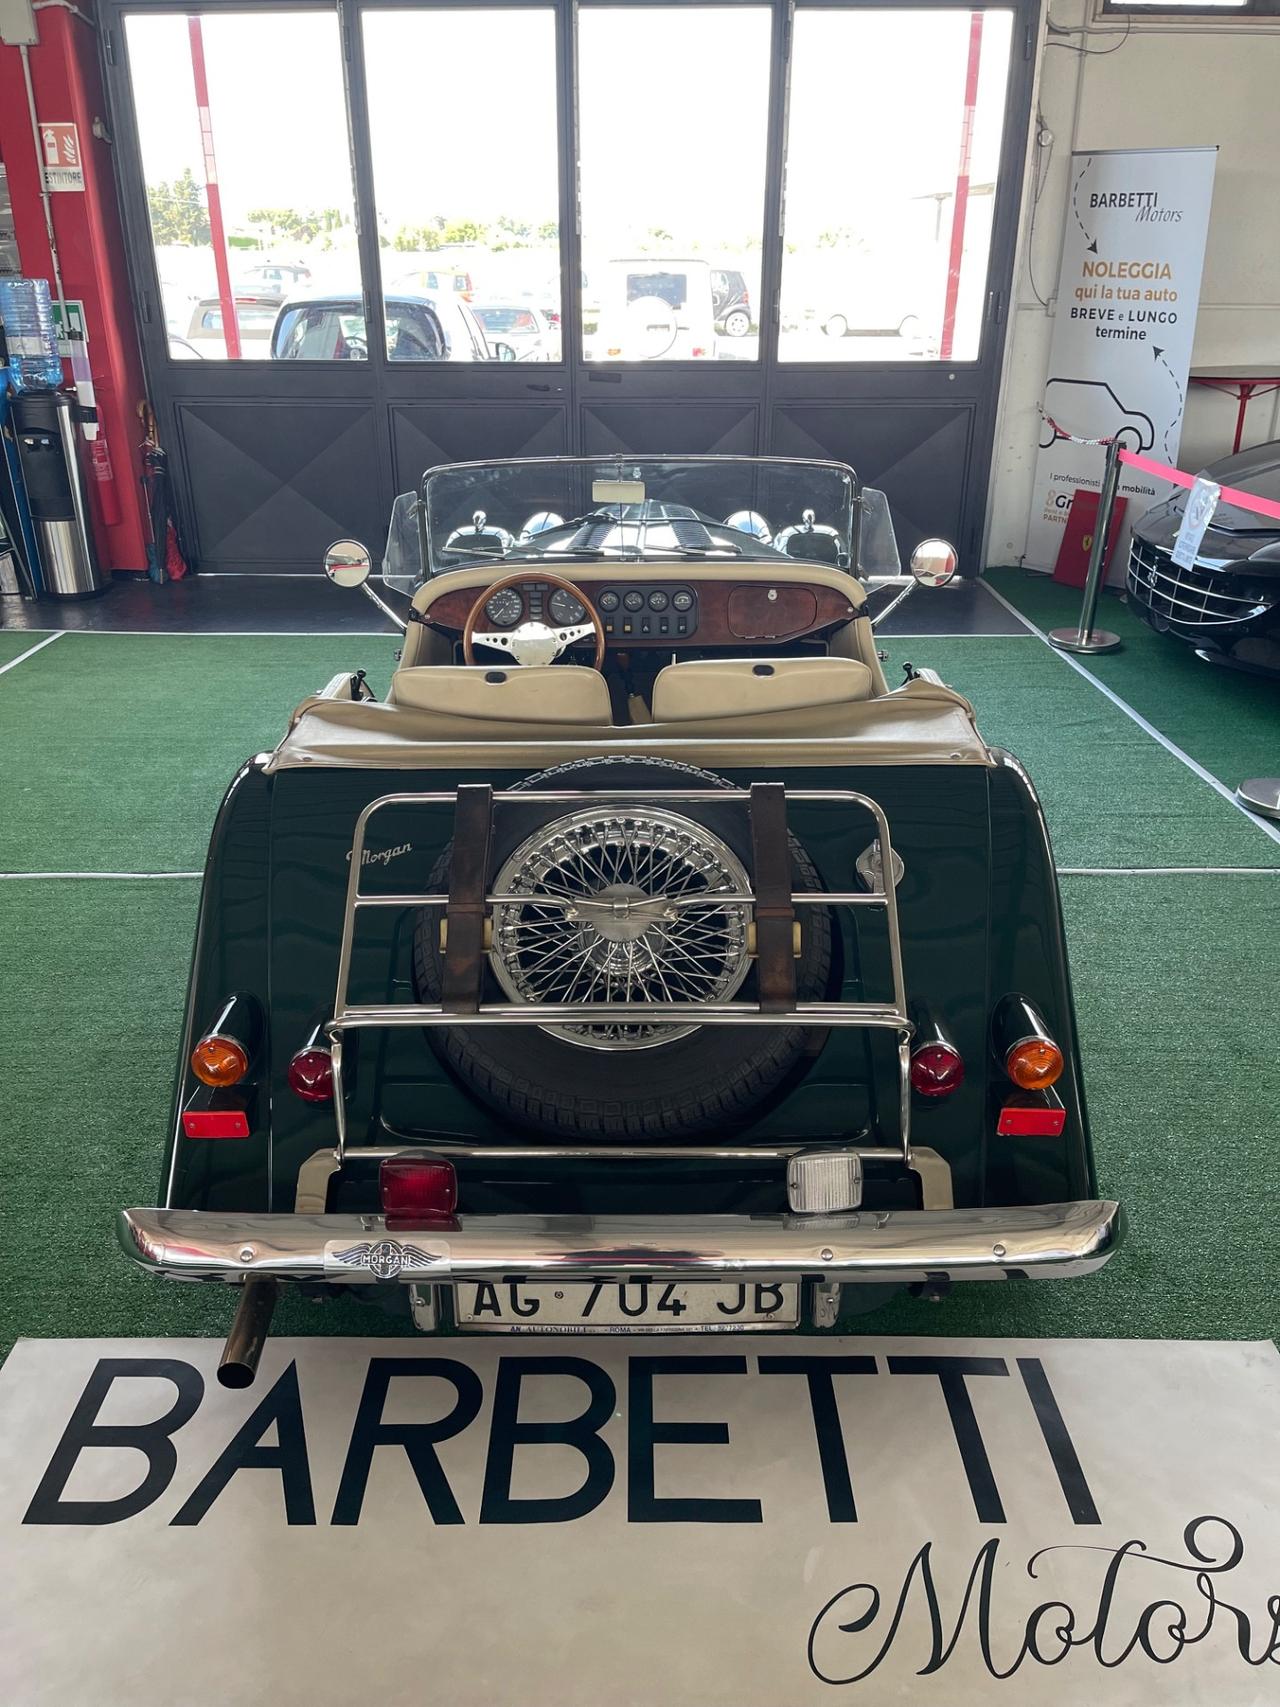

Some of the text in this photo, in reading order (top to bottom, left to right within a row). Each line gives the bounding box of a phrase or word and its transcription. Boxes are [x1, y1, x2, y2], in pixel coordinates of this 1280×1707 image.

[44, 171, 82, 184] ESTINTORE
[1089, 192, 1158, 208] BARBETTI
[1135, 206, 1184, 223] Motors
[1082, 261, 1172, 280] NOLEGGIA
[1075, 284, 1178, 302] qui la tua auto
[1070, 307, 1178, 324] BREVE e LUNGO
[1095, 326, 1147, 341] termine
[1053, 473, 1101, 488] professionisti
[1121, 484, 1156, 496] mobilità
[1055, 494, 1073, 510] Gr
[1043, 513, 1067, 525] PARTN
[346, 842, 413, 866] Morgan
[362, 1254, 409, 1265] MORGAN
[473, 1283, 540, 1317] AG
[716, 1283, 784, 1316] JB
[22, 1355, 1102, 1526] BARBETTI
